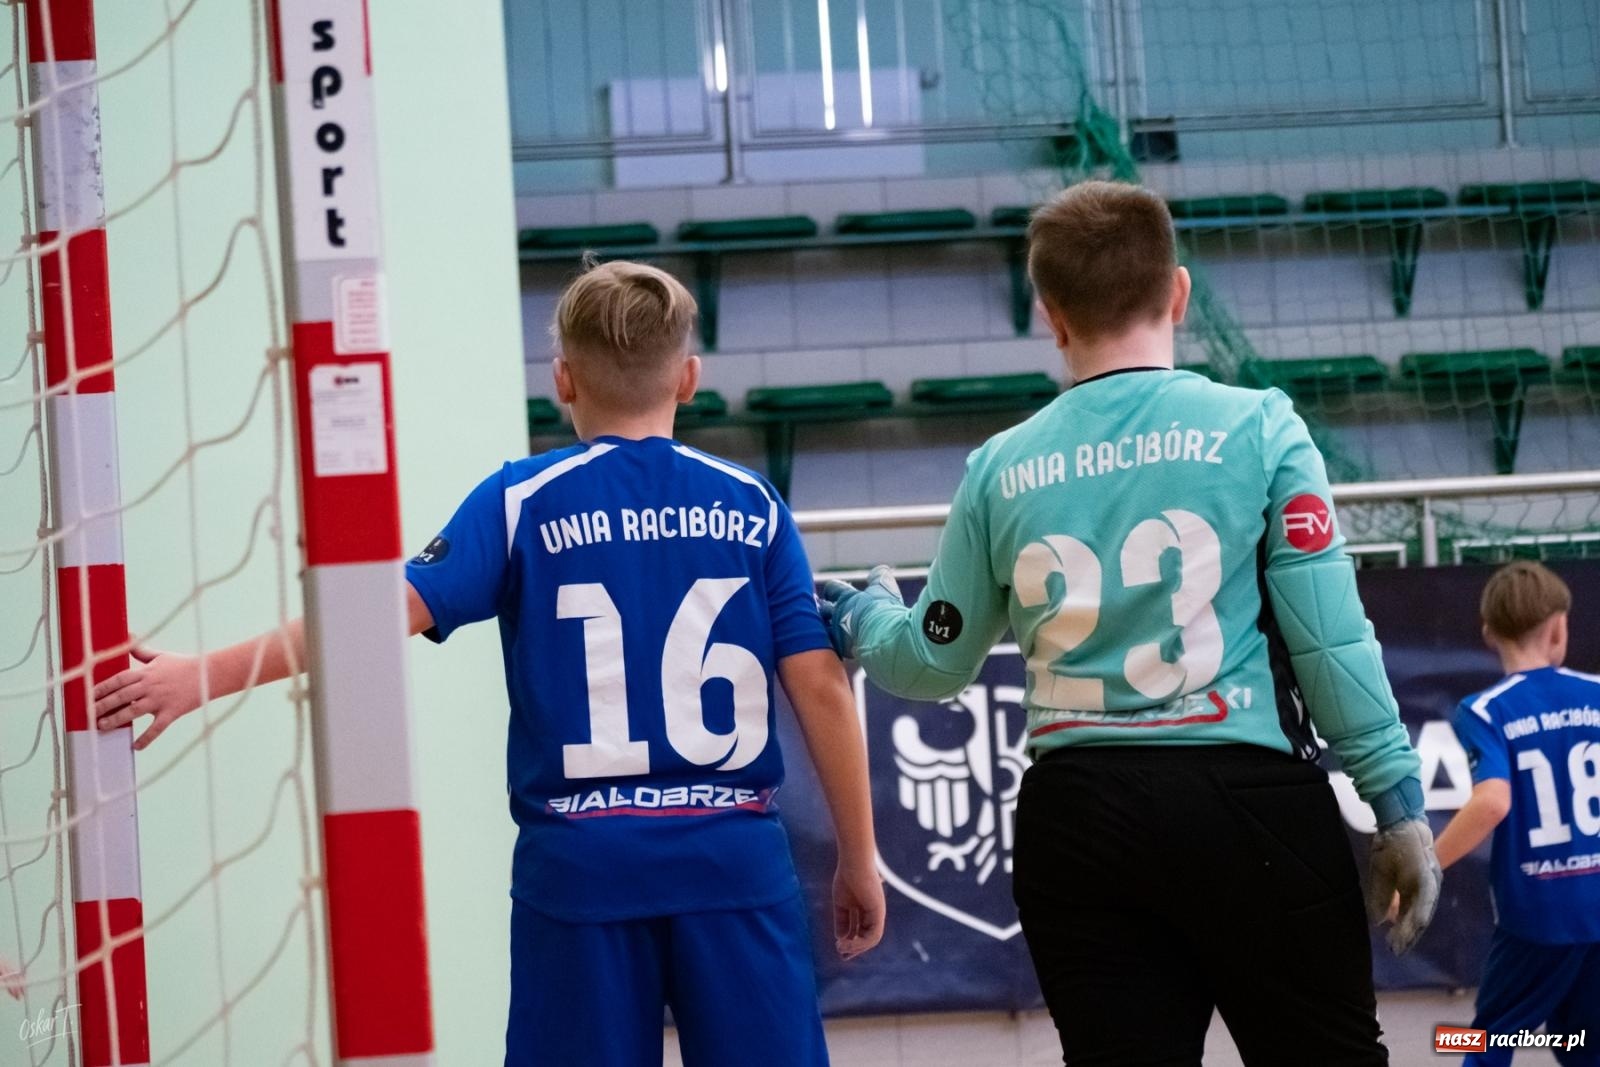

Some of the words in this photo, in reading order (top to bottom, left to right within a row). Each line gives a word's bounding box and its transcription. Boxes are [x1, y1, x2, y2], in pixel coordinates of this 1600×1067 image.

[311, 19, 346, 248] sport
[1000, 451, 1065, 499] UNIA
[1075, 421, 1228, 478] RACIBÓRZ
[540, 508, 612, 555] UNIA
[622, 501, 767, 548] RACIBÓRZ
[928, 620, 950, 639] 1v1
[1013, 509, 1224, 711] 23
[556, 577, 769, 779] 16
[1503, 715, 1540, 741] UNIA
[1517, 740, 1600, 848] 18
